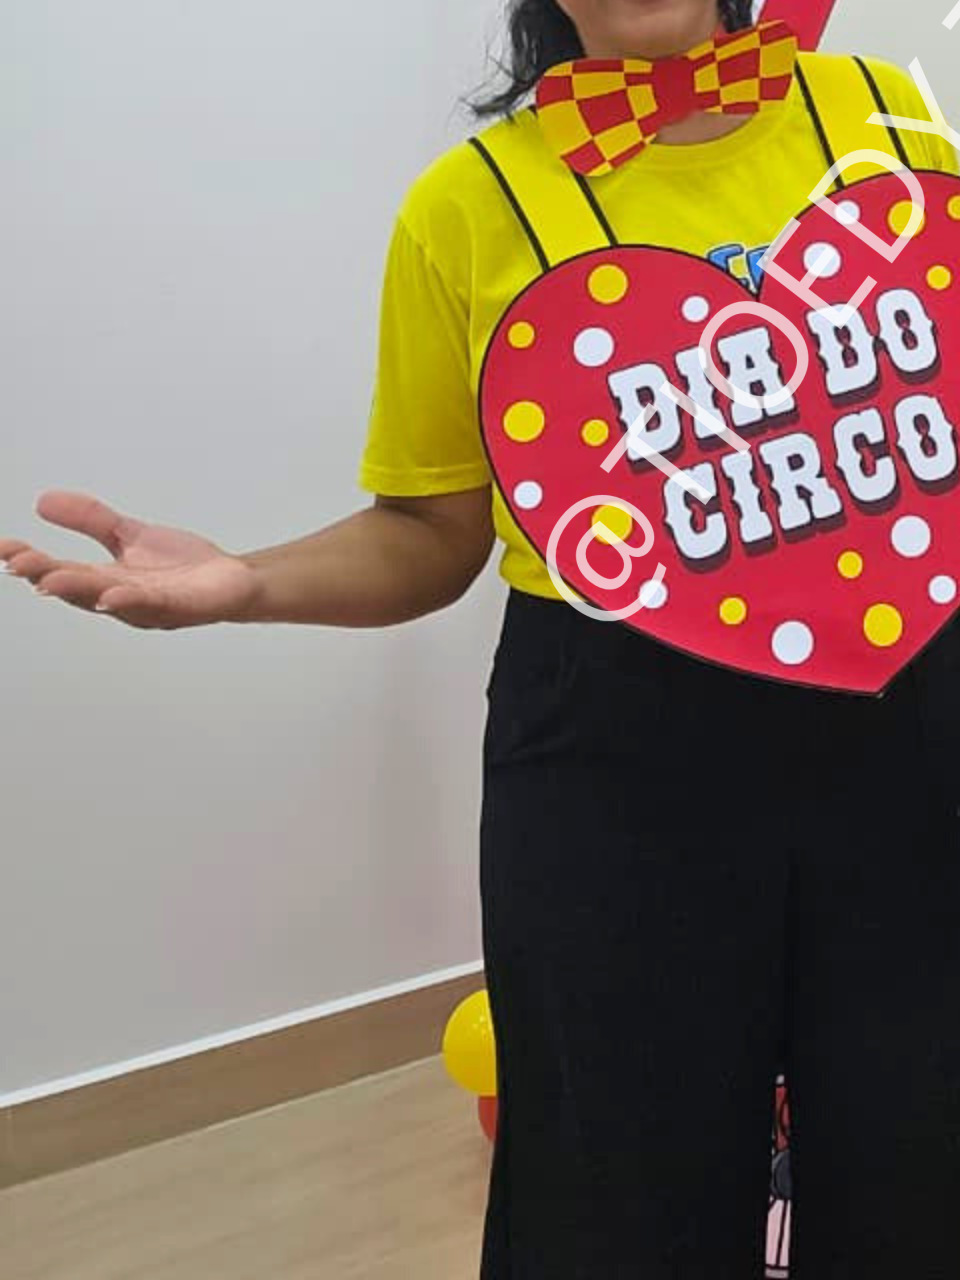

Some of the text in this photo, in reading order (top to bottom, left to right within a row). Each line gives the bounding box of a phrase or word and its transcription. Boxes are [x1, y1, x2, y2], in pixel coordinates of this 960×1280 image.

[607, 288, 940, 465] DIA DO
[662, 393, 960, 567] CIRCO
